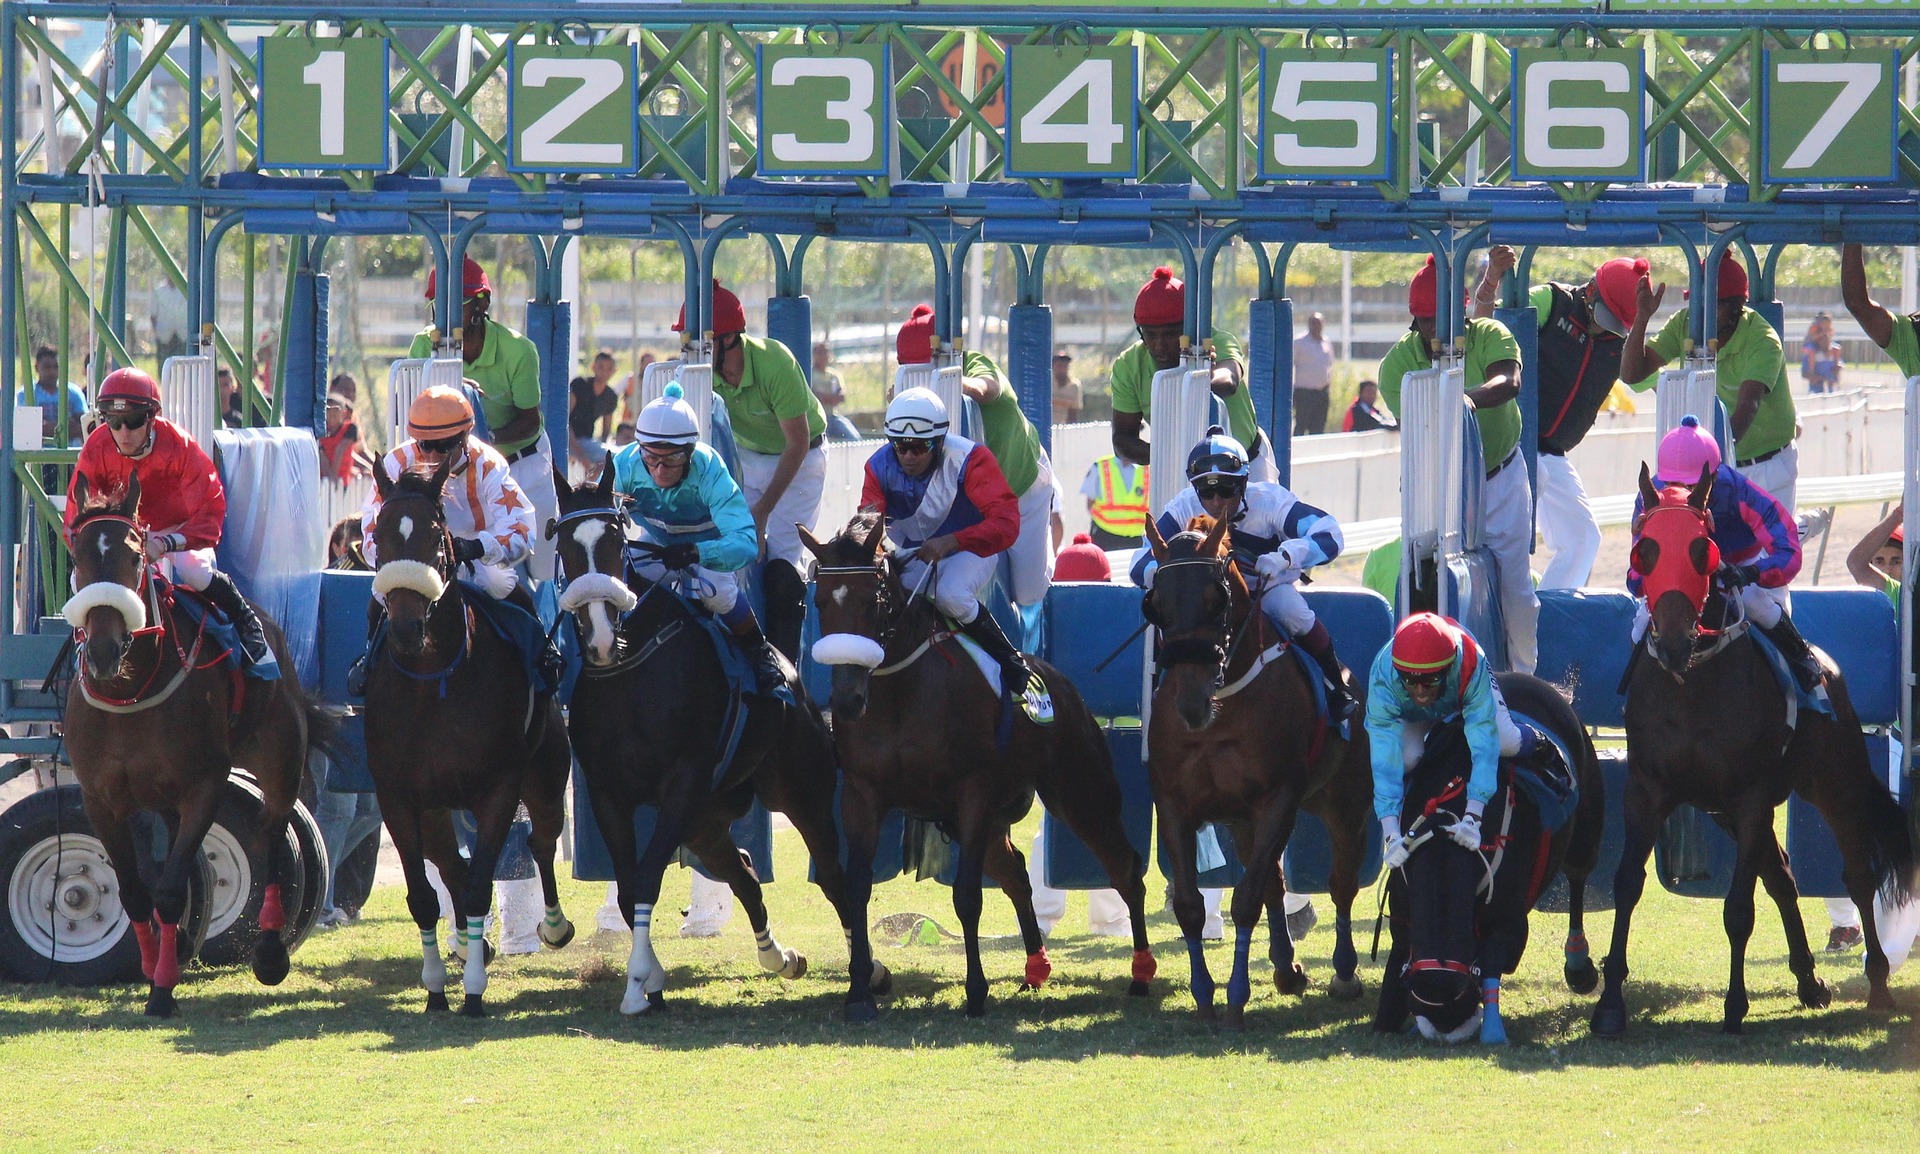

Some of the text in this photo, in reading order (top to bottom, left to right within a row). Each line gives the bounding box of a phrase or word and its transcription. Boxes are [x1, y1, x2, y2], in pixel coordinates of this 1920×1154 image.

[304, 51, 345, 155] 1
[521, 58, 623, 163] 2
[772, 58, 874, 161] 3
[1021, 60, 1123, 163] 4
[1272, 62, 1377, 166] 5
[1525, 62, 1629, 167] 6
[1778, 63, 1881, 168] 7
